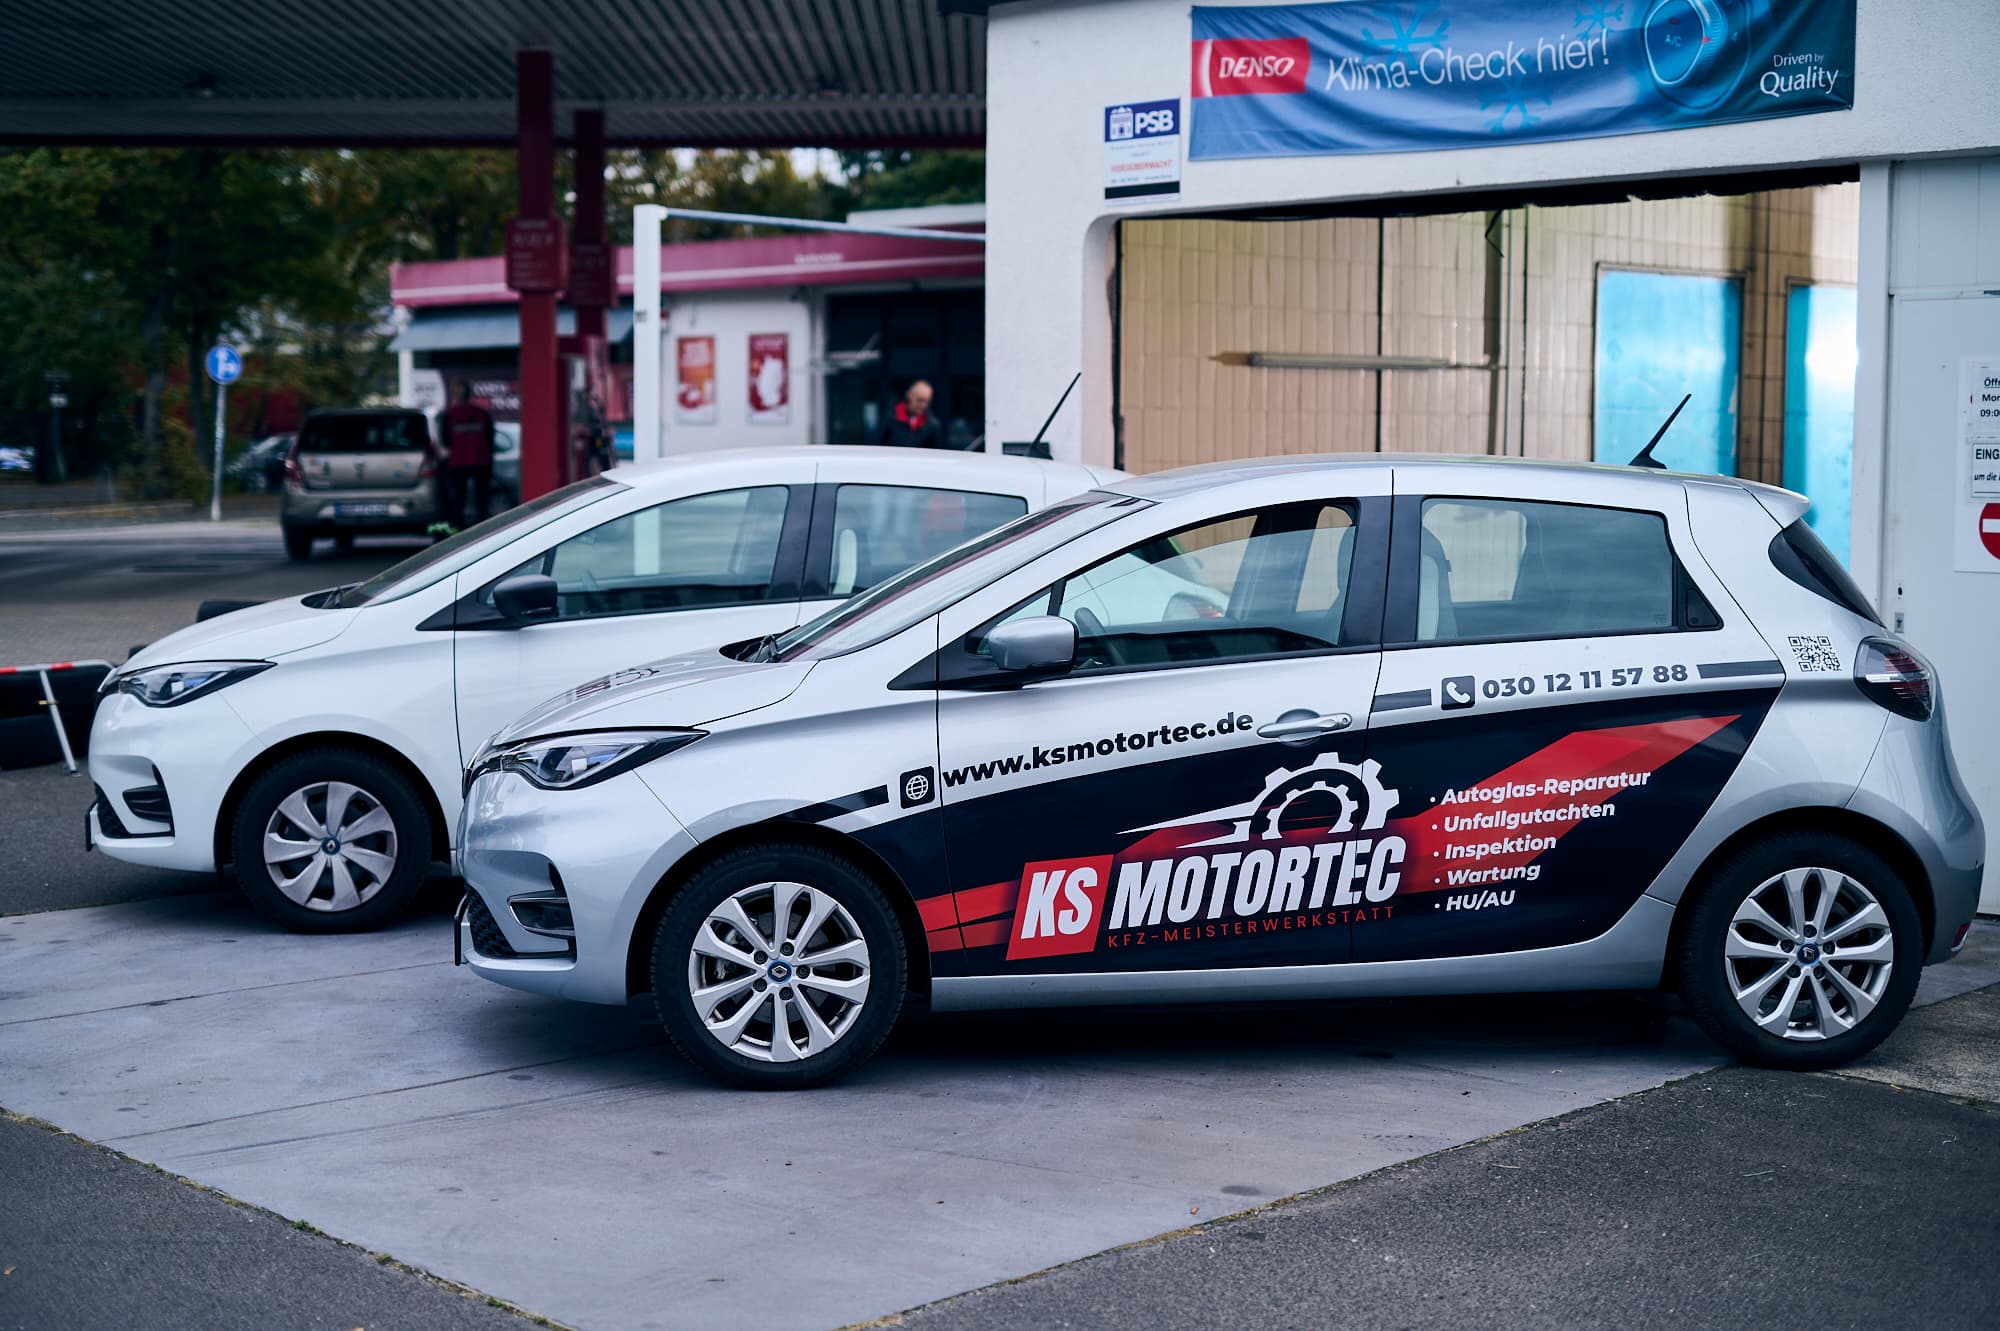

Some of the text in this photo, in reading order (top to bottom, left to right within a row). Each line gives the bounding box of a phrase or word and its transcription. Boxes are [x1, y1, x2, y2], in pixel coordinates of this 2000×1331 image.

[1664, 33, 1683, 47] A/C
[1218, 55, 1295, 79] DENSO
[1325, 28, 1609, 91] Klima-Check hier!
[1773, 52, 1824, 68] Driven by
[1759, 66, 1839, 97] Quality
[1134, 109, 1174, 134] PSB
[1980, 409, 2000, 417] 09:0
[1975, 448, 2000, 460] EING
[1974, 473, 1985, 481] um
[1986, 472, 1997, 481] die
[1482, 664, 1688, 698] 030 12 11 57 88
[942, 711, 1254, 788] www.ksmotortec.de
[1441, 771, 1651, 806] Autoglas-Reparatur
[1444, 802, 1616, 832] Unfallgutachten
[1444, 834, 1557, 860] Inspektion
[1447, 864, 1541, 885] Wartung
[1020, 835, 1407, 940] KS MOTORTEC
[1446, 890, 1516, 911] HU/AU
[1108, 905, 1394, 948] KFZ-MEISTERWERKSTATT
